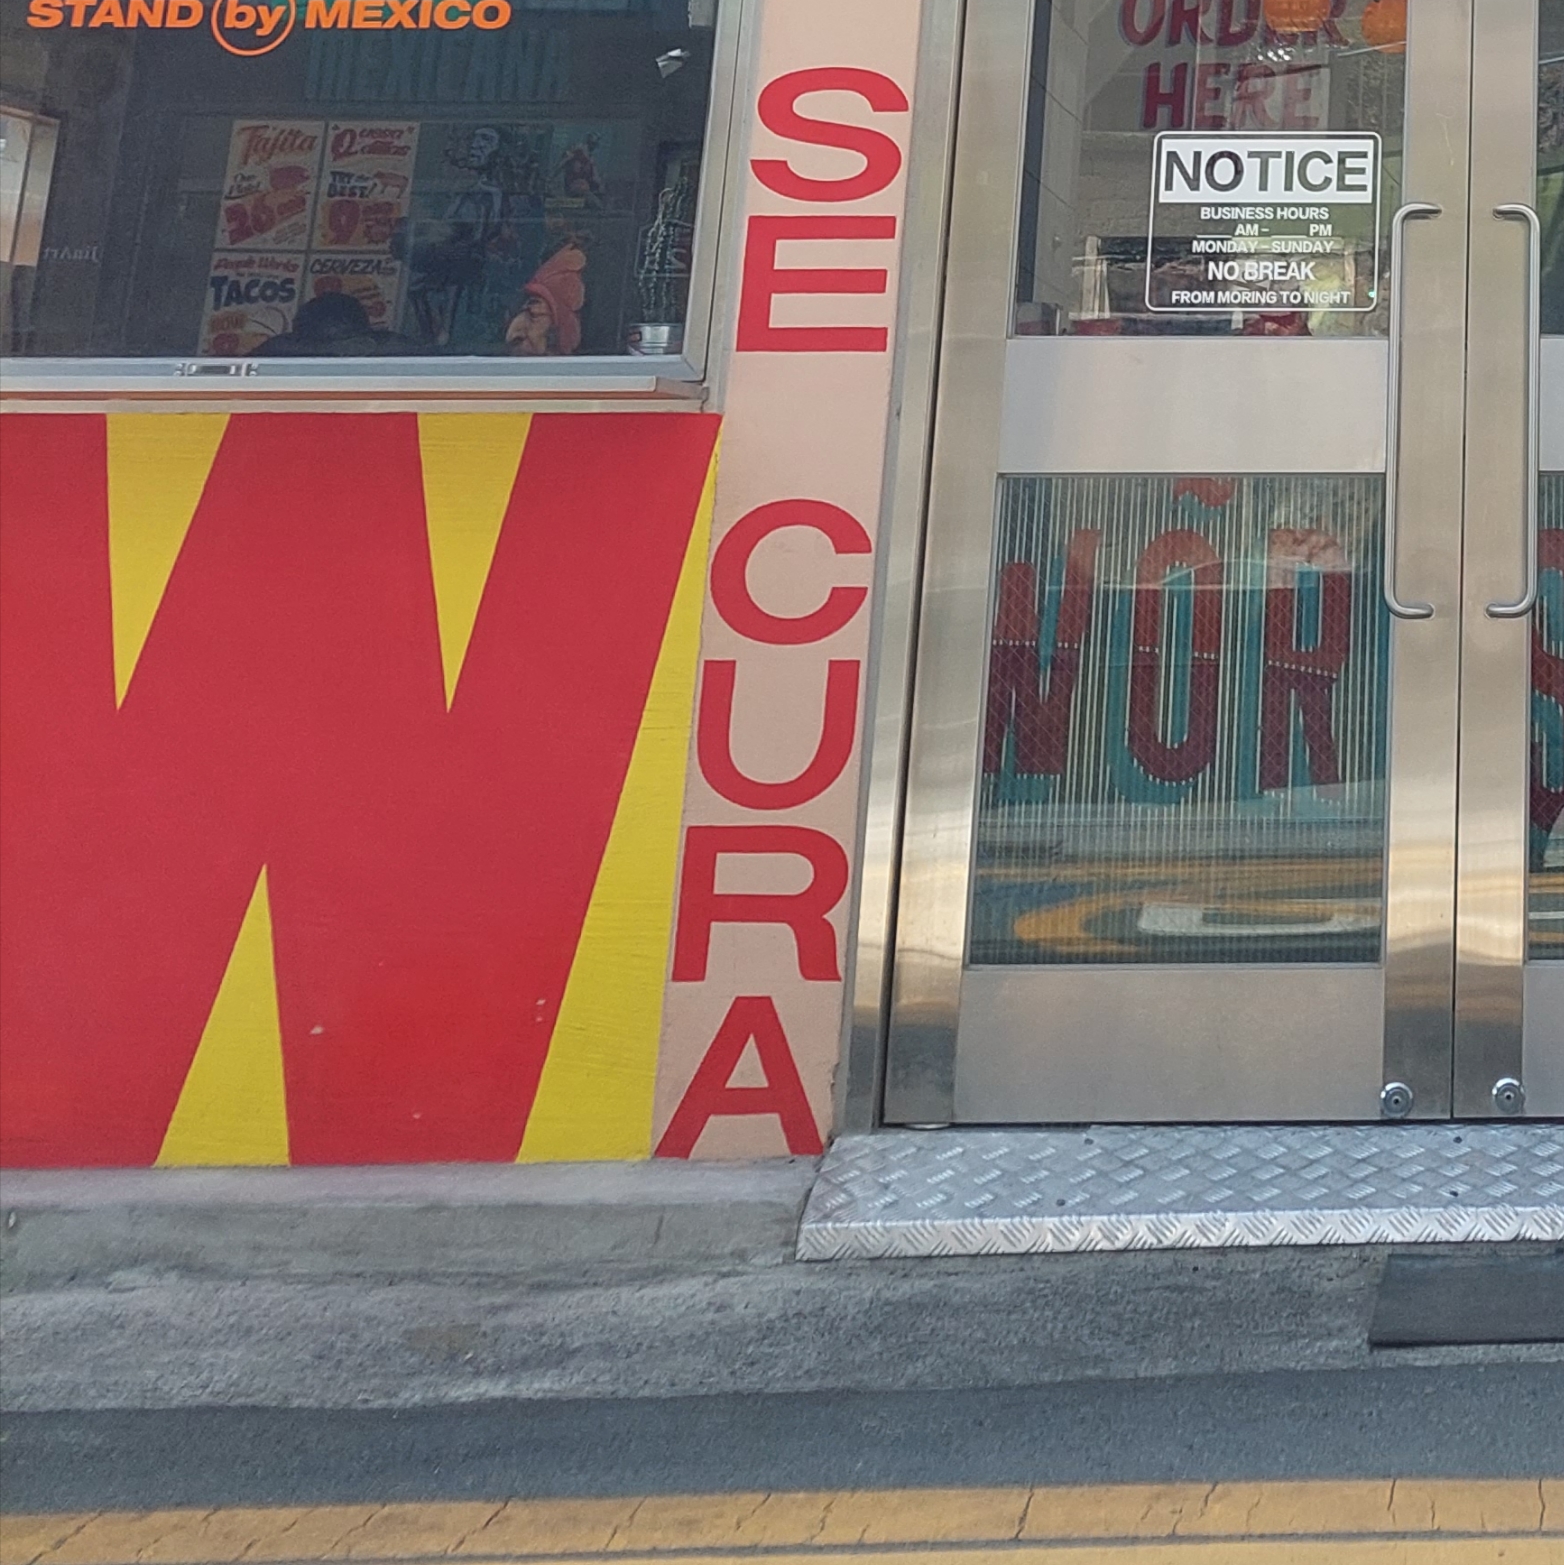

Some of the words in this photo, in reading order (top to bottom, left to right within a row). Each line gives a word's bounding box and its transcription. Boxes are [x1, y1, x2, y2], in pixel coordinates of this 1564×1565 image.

[1142, 62, 1322, 131] HERE
[1164, 151, 1369, 193] NOTICE
[1200, 207, 1274, 220] BUSINESS
[1276, 207, 1329, 220] HOURS
[1309, 224, 1333, 237] PM
[1192, 239, 1258, 253] MONDAY
[1271, 239, 1334, 253] SUNDAY
[1207, 261, 1240, 280] NO
[1244, 261, 1316, 280] BREAK
[210, 275, 297, 311] TACOS
[1171, 291, 1215, 304] FROM
[1217, 291, 1277, 304] MORING
[1278, 291, 1302, 304] TO
[1303, 291, 1351, 304] NIGHT
